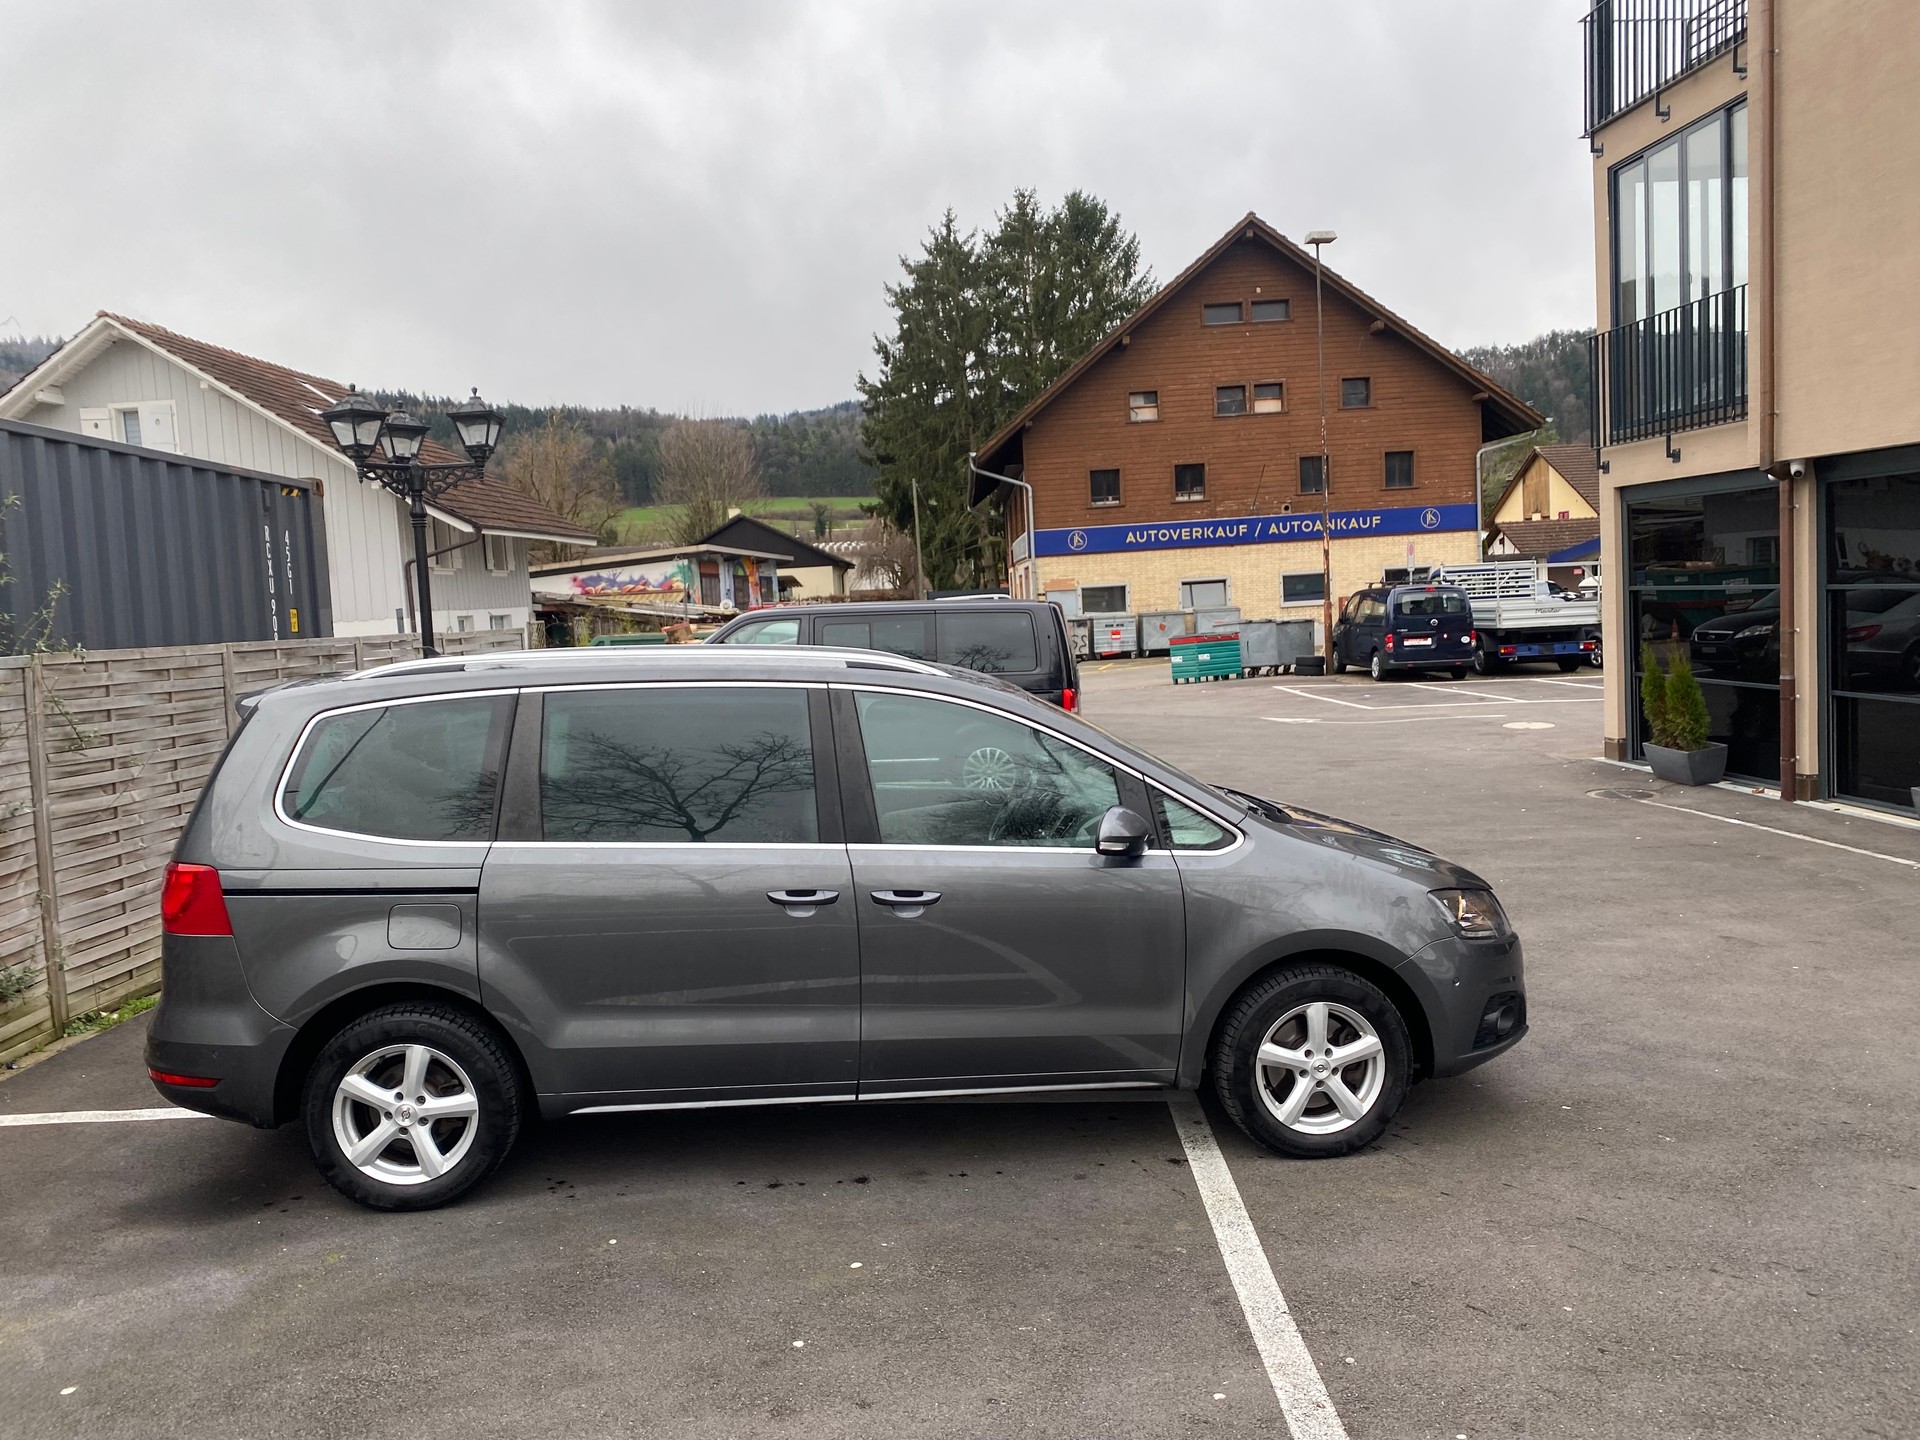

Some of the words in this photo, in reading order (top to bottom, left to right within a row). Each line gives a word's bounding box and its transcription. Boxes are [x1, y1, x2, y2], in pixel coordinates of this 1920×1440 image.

[1125, 524, 1248, 543] AUTOVERKAUF
[1268, 516, 1381, 534] AUTOANKAUF
[284, 530, 293, 595] 45G1
